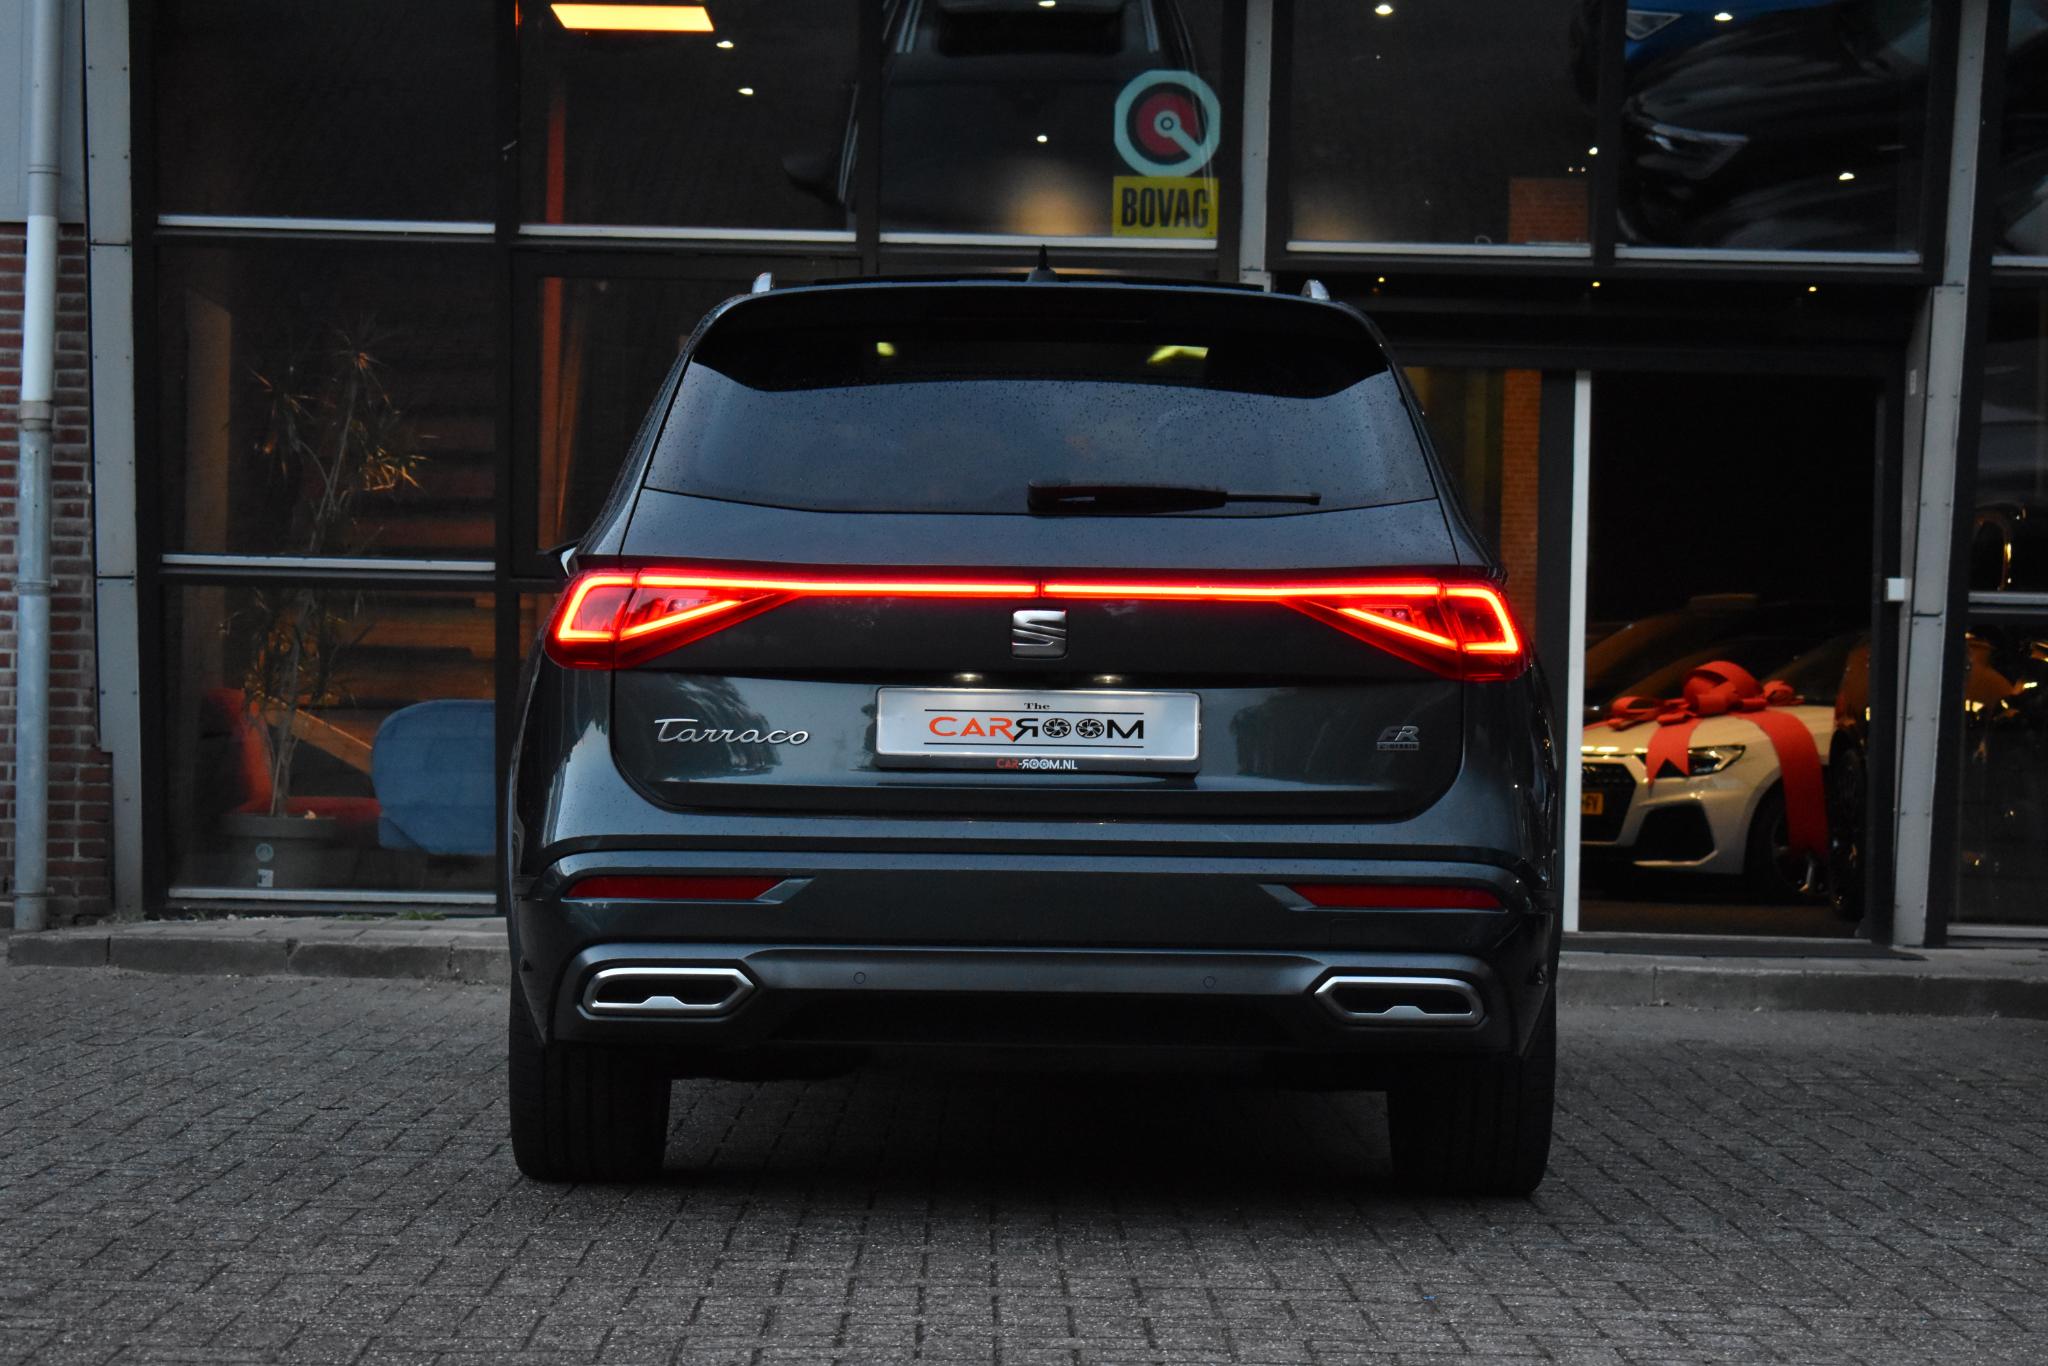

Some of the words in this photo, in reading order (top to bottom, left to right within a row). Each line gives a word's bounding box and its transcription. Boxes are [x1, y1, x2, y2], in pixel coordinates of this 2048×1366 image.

[1121, 187, 1209, 228] BOVAG
[1023, 702, 1051, 710] The
[654, 718, 809, 745] Tarraco
